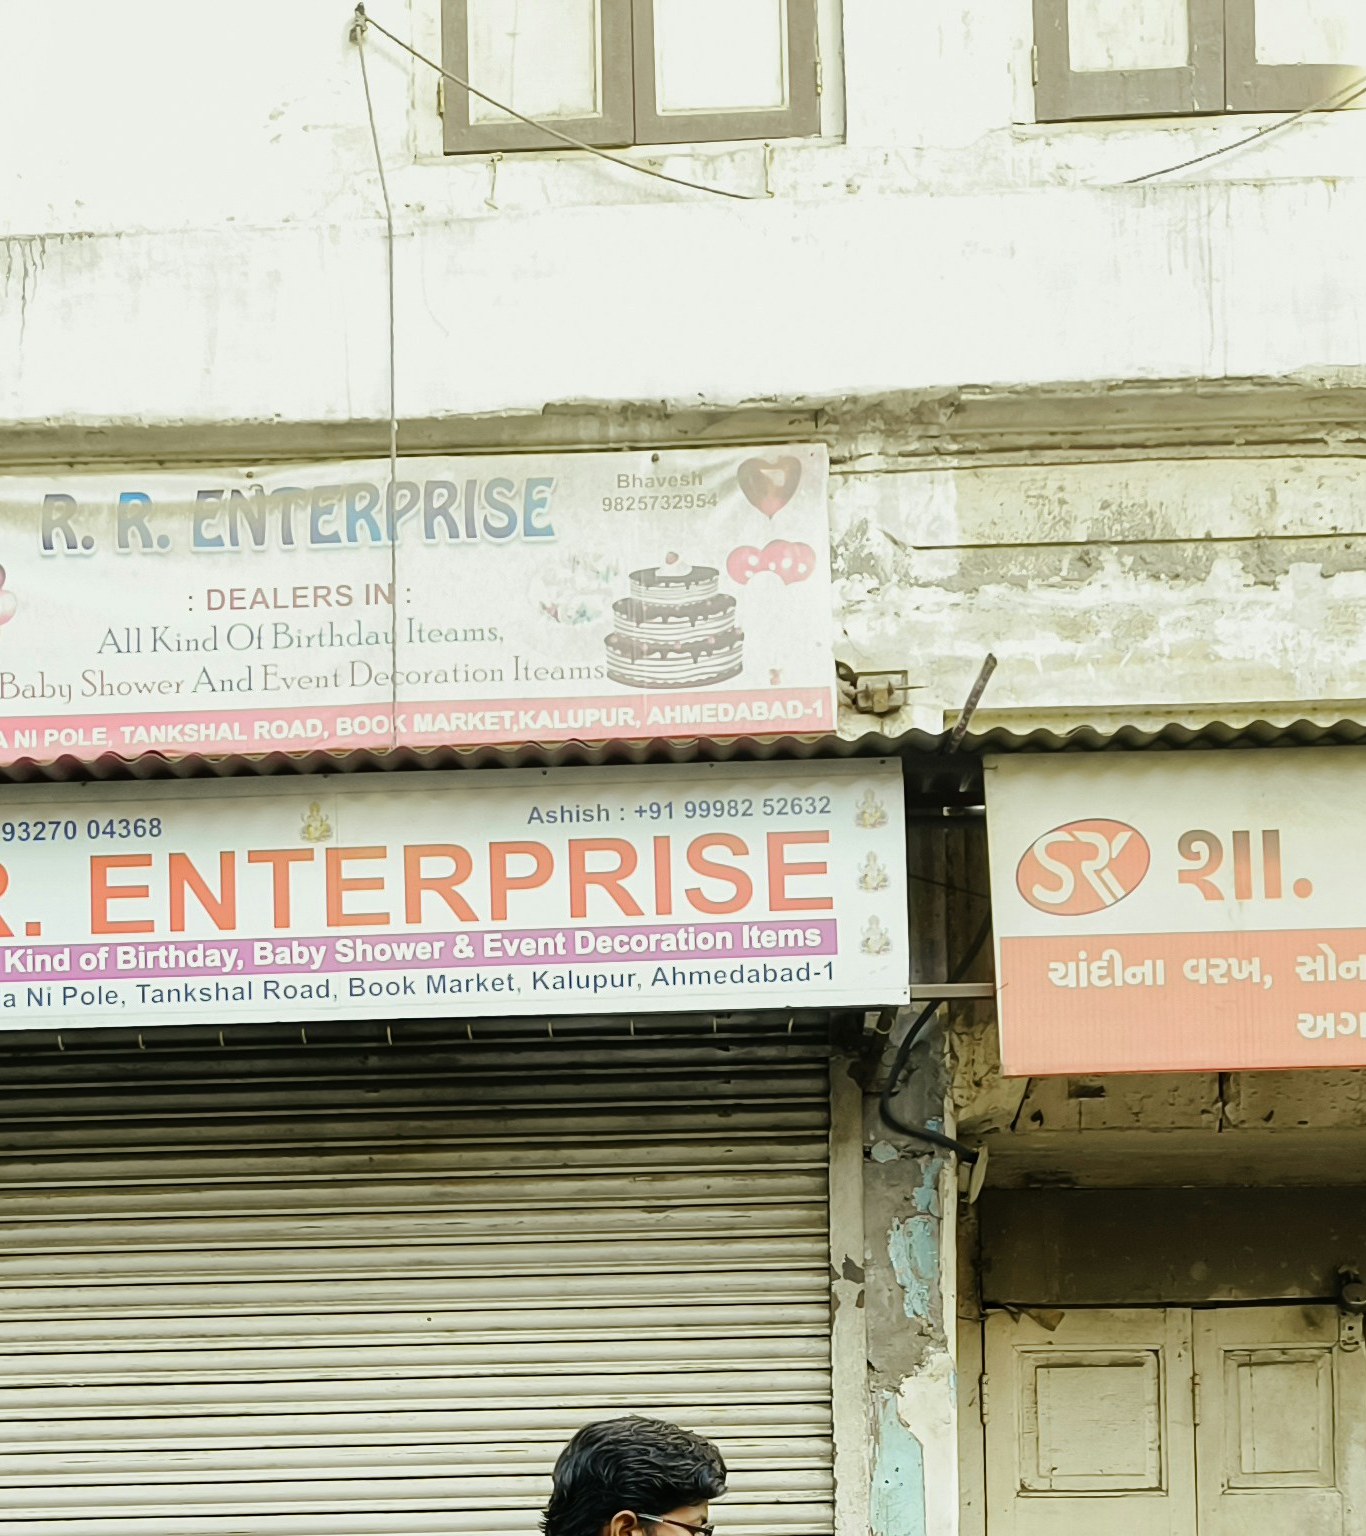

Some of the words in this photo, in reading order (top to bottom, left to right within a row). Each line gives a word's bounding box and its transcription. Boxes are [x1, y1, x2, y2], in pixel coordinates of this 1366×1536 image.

[617, 471, 703, 489] Bhavesh
[42, 494, 94, 550] R.
[117, 492, 170, 548] R.
[193, 477, 555, 547] ENTERPRISE
[602, 493, 718, 512] 9825732954
[207, 585, 353, 611] DEALERS
[365, 583, 393, 606] IN
[98, 628, 141, 654] All
[151, 626, 218, 653] Kind
[227, 623, 264, 651] Of
[407, 617, 504, 644] Iteams,
[81, 669, 184, 698] Shower
[192, 666, 253, 693] And
[261, 664, 340, 691] Event
[349, 660, 504, 687] Decoration
[513, 656, 605, 683] Iteams
[14, 730, 37, 749] NI
[44, 727, 112, 748] POLE,
[120, 723, 247, 744] TANKSHAL
[254, 718, 328, 741] ROAD,
[336, 714, 405, 737] BOOK
[647, 700, 823, 725] AHMEDABAD-1
[2, 820, 77, 842] 93270
[87, 818, 162, 840] 04368
[528, 804, 610, 825] Ashish
[634, 802, 674, 819] +91
[684, 799, 754, 819] 99982
[763, 796, 831, 816] 52632
[90, 830, 833, 934] ENTERPRISE
[1177, 829, 1313, 901] શા.
[4, 947, 70, 973] Kind
[79, 946, 109, 970] of
[117, 943, 244, 972] Birthday,
[253, 941, 327, 970] Baby
[335, 937, 444, 963] Shower
[453, 934, 474, 959] &
[483, 931, 566, 957] Event
[574, 927, 733, 955] Decoration
[742, 924, 822, 950] Items
[1047, 948, 1164, 988] ચાંદીના
[1182, 957, 1272, 989] વરખ,
[27, 985, 52, 1008] Ni
[63, 985, 126, 1007] Pole,
[135, 981, 252, 1004] Tankshal
[263, 979, 337, 1002] Road,
[349, 976, 416, 997] Book
[427, 973, 521, 995] Market,
[533, 969, 642, 994] Kalupur,
[651, 962, 834, 987] Ahmedabad-1
